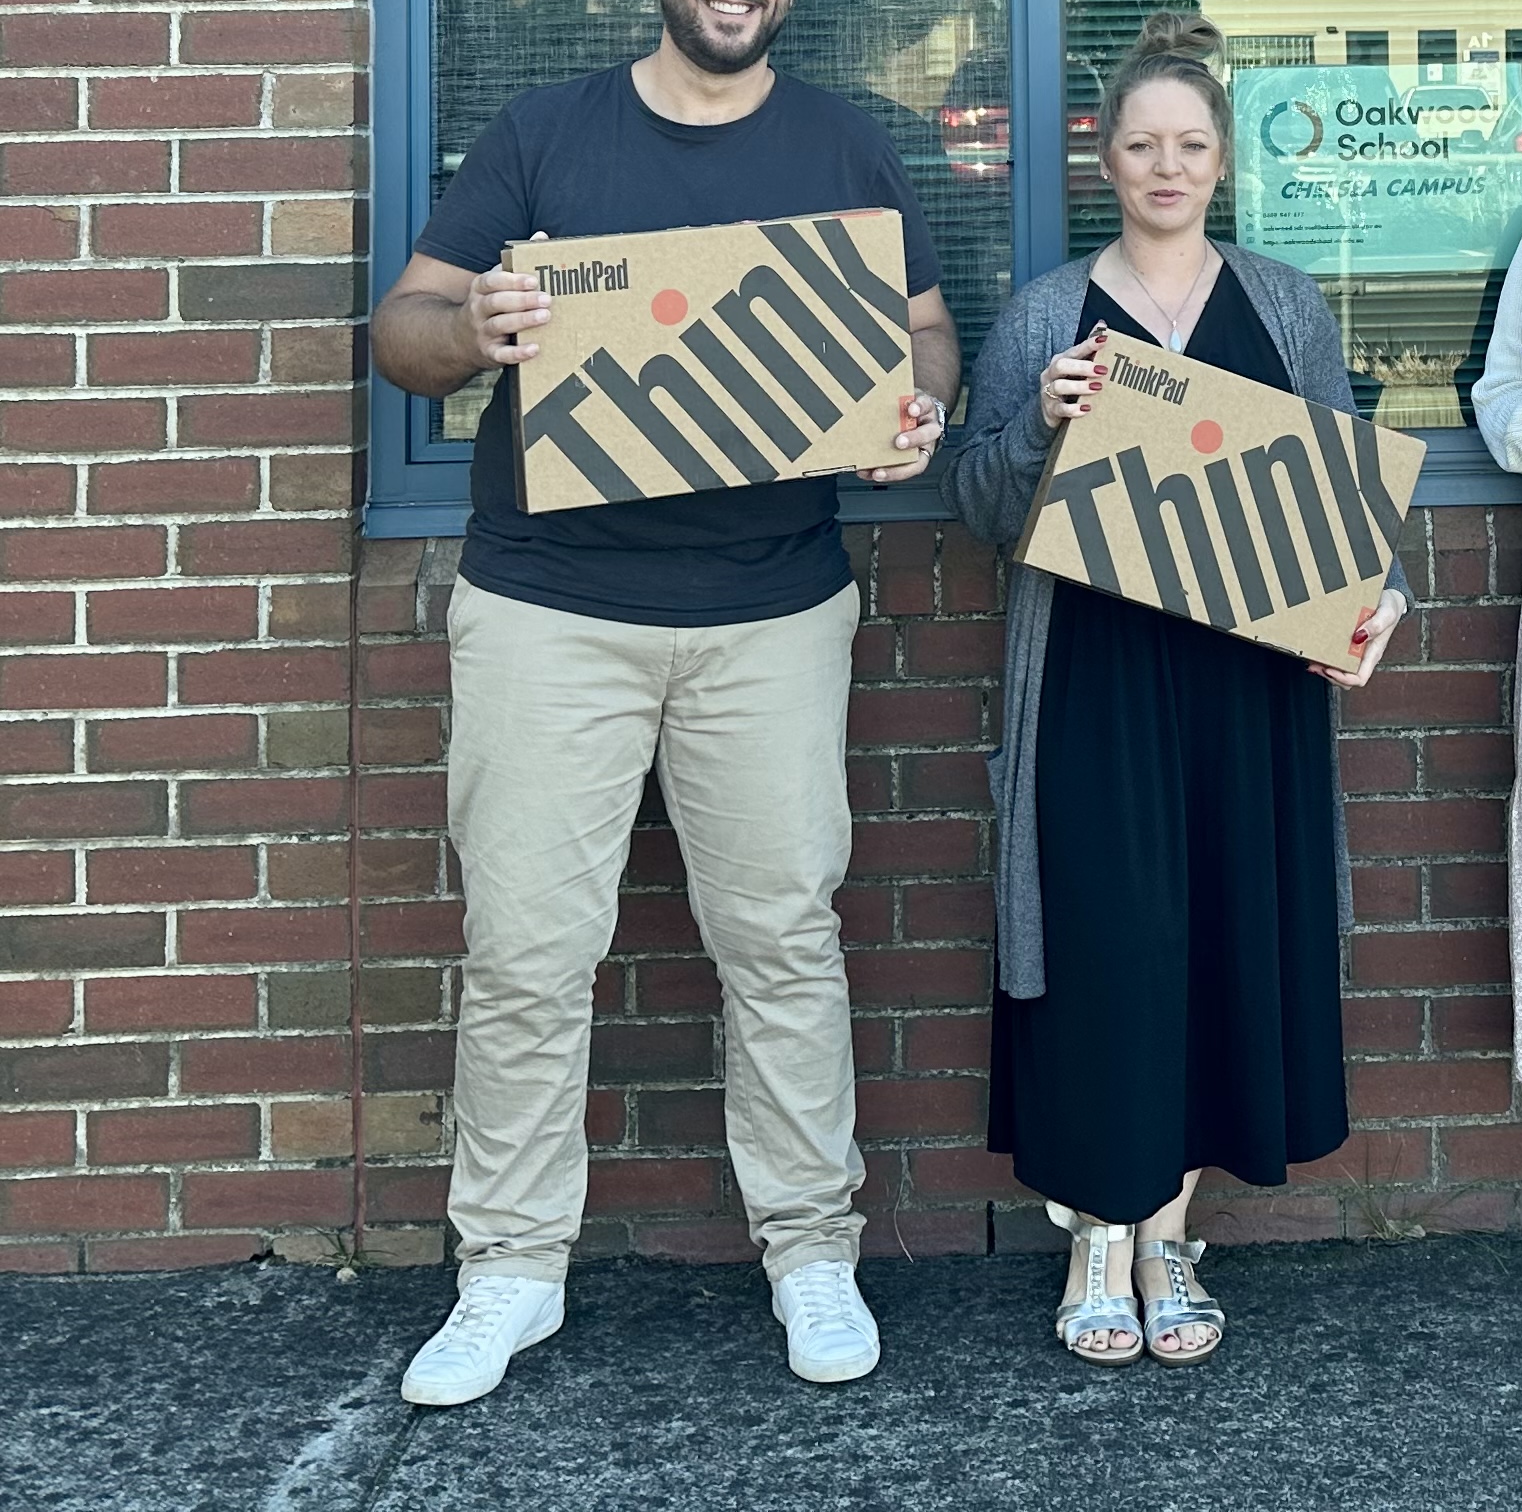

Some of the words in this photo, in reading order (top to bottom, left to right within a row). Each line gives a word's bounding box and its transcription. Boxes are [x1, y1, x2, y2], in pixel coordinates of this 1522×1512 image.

[1336, 98, 1499, 126] Oakwood
[1337, 131, 1449, 161] School
[1387, 176, 1486, 198] CAMPUS
[535, 258, 629, 296] ThinkPad
[524, 218, 909, 504] Think
[1109, 352, 1190, 406] ThinkPad
[1042, 399, 1406, 630] Think
